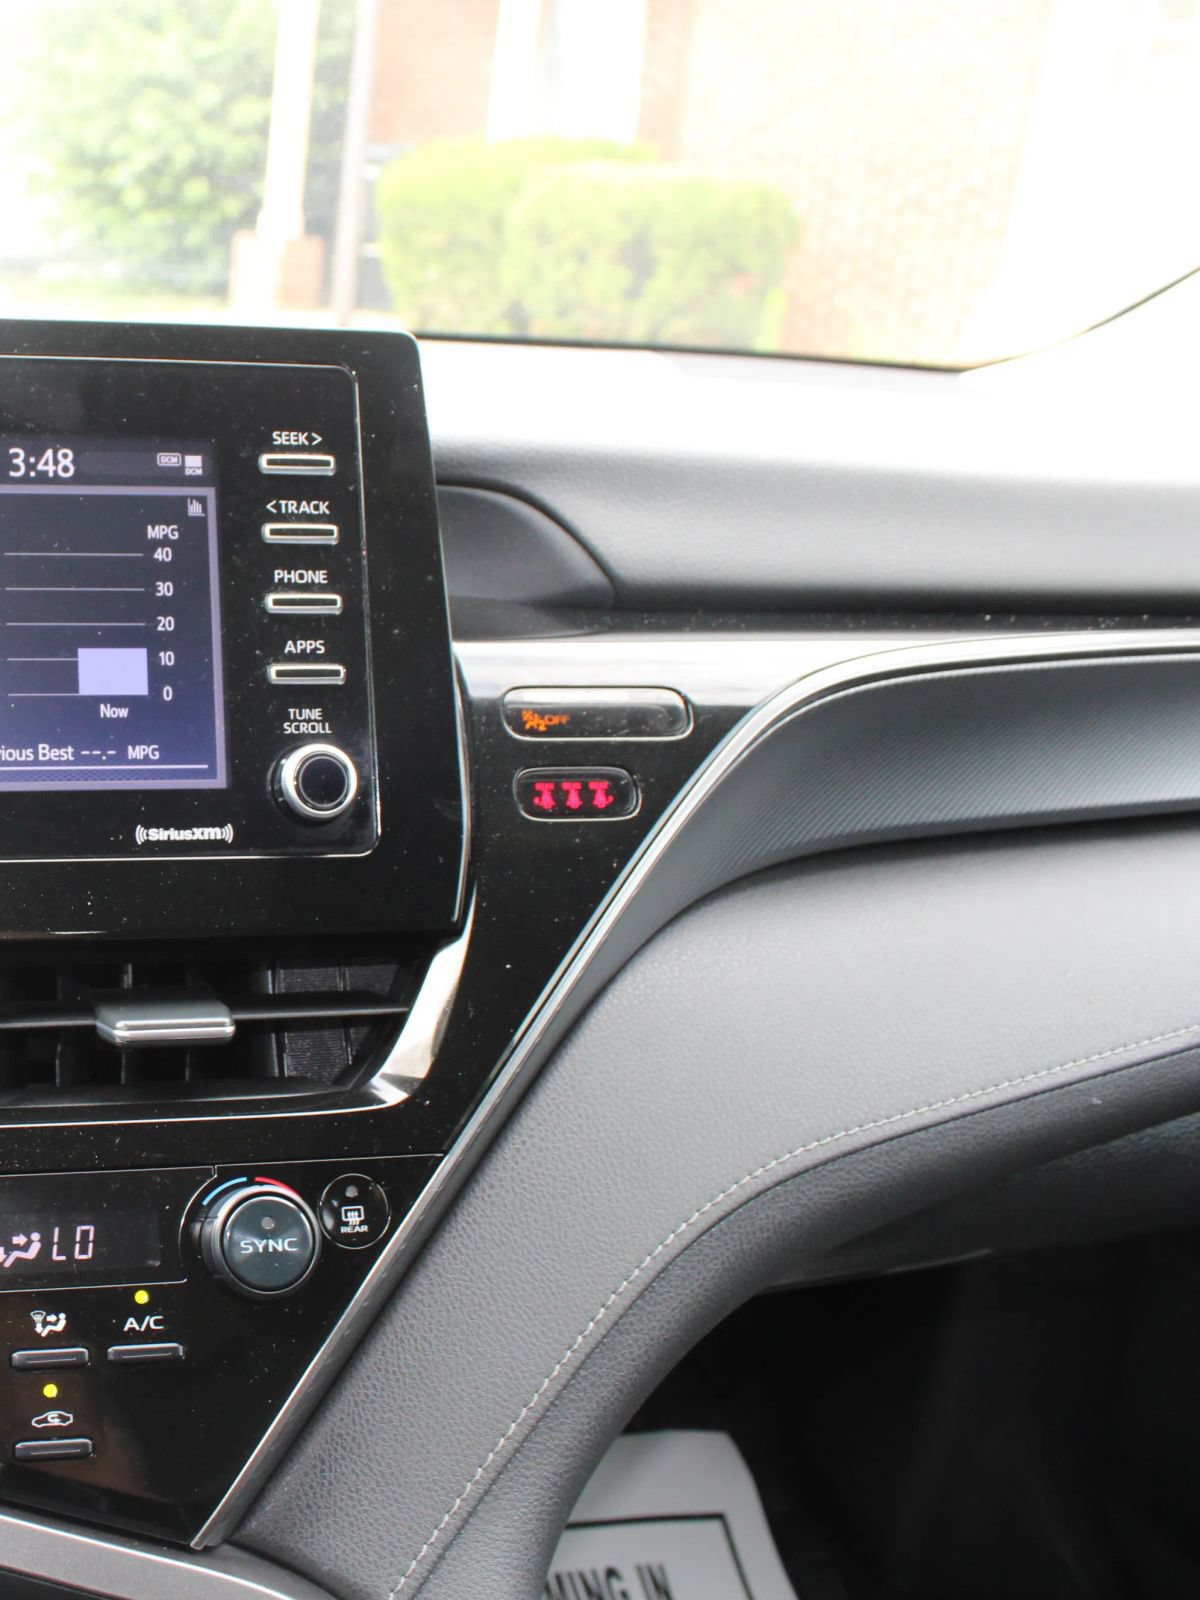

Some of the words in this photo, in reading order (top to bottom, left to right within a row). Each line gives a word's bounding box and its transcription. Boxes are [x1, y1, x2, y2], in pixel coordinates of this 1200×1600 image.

[8, 448, 74, 477] 3:48
[148, 525, 179, 540] MPG
[154, 548, 172, 562] 40
[274, 570, 327, 583] PHONE
[155, 582, 173, 596] 30
[157, 617, 175, 631] 20
[285, 640, 325, 654] APPS
[158, 652, 175, 666] 10
[163, 687, 172, 700] 0
[100, 705, 128, 718] Now
[289, 708, 322, 720] TUNE
[545, 714, 570, 725] OFF
[283, 722, 332, 734] SCROLL
[38, 745, 74, 761] Best
[127, 745, 159, 760] MPG
[341, 1225, 368, 1233] REAR
[240, 1237, 298, 1254] SYNC
[124, 1315, 164, 1331] A/C
[636, 1562, 675, 1600] IN
